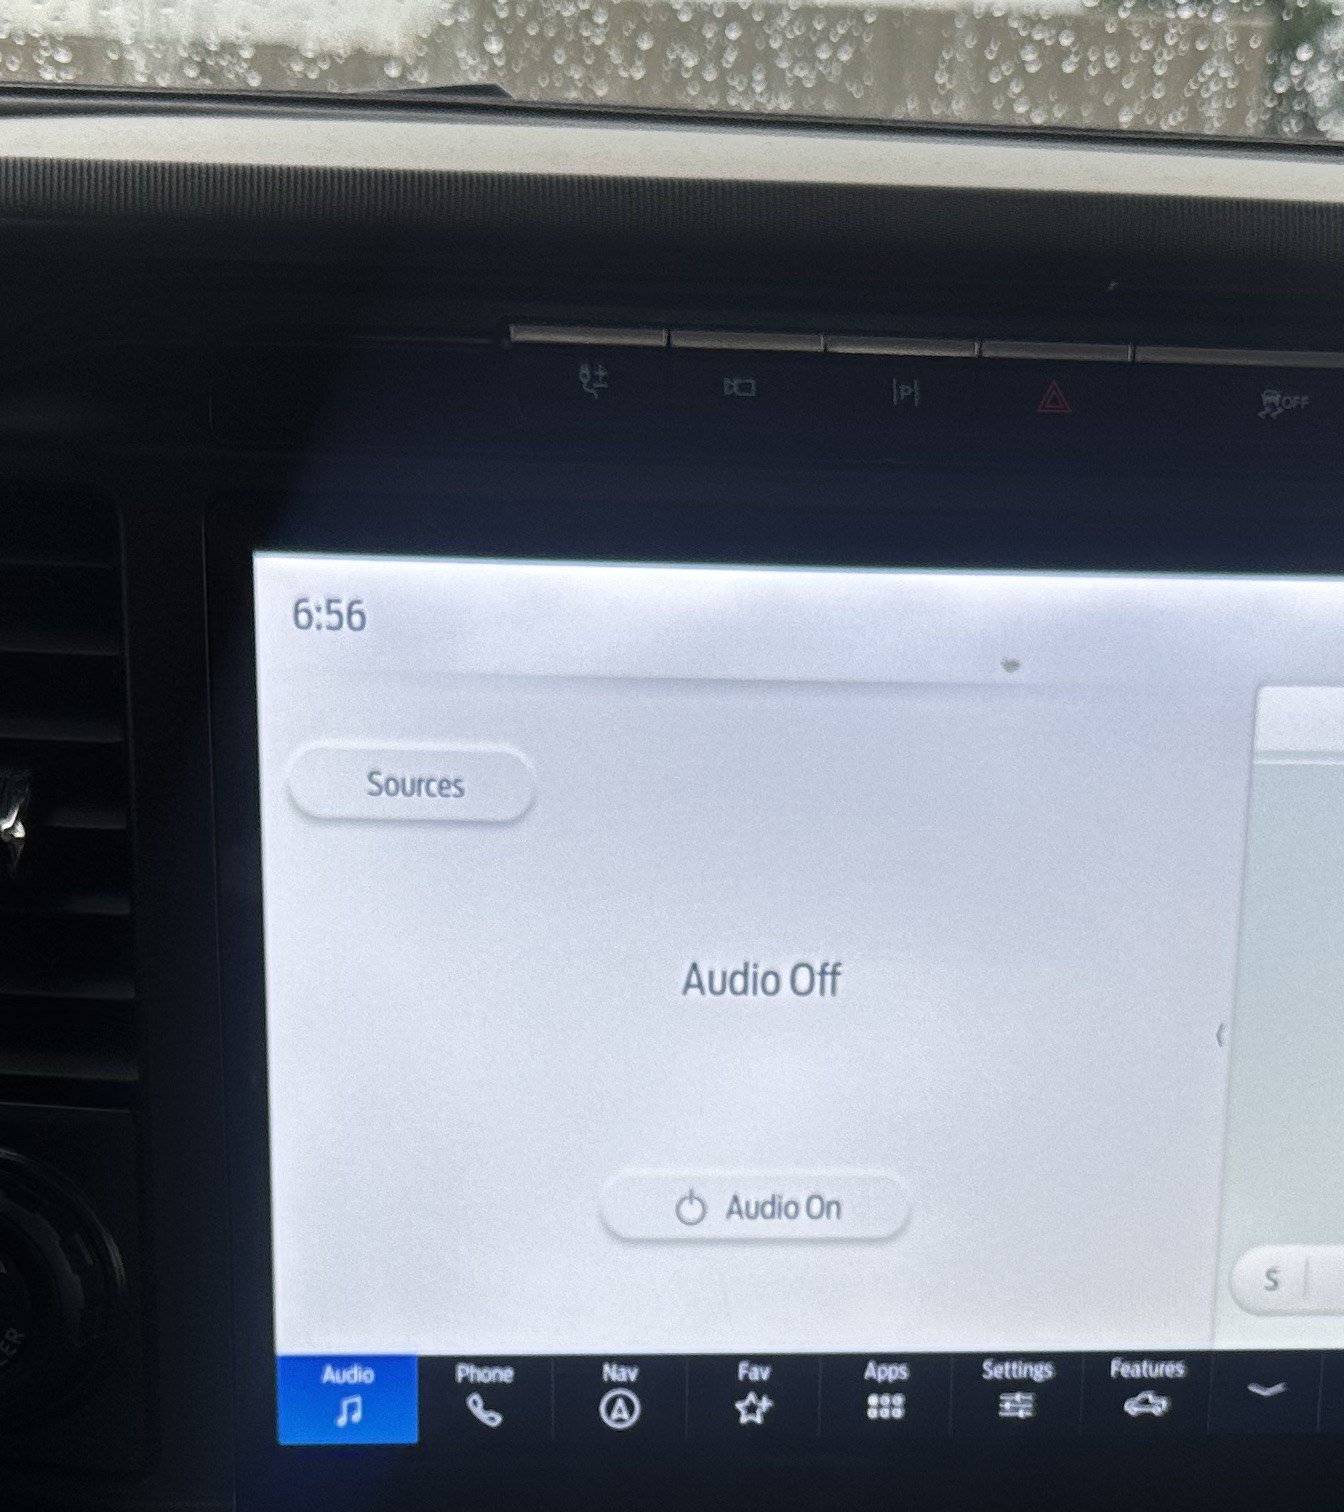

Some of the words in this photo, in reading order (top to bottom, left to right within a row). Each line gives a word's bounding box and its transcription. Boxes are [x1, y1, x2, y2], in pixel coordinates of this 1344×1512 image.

[1282, 396, 1309, 409] OFF
[292, 598, 367, 632] 6:56
[367, 769, 465, 798] Sources
[682, 960, 781, 997] Audio
[789, 960, 844, 997] Off
[726, 1194, 800, 1221] Audio
[805, 1194, 842, 1221] On
[1264, 1268, 1280, 1291] S
[322, 1364, 375, 1385] Audio
[456, 1363, 515, 1384] Phone
[602, 1363, 639, 1383] Nav
[738, 1362, 772, 1382] Fav
[864, 1360, 909, 1383] Apps
[982, 1359, 1055, 1382] Settings
[1110, 1357, 1186, 1379] Features
